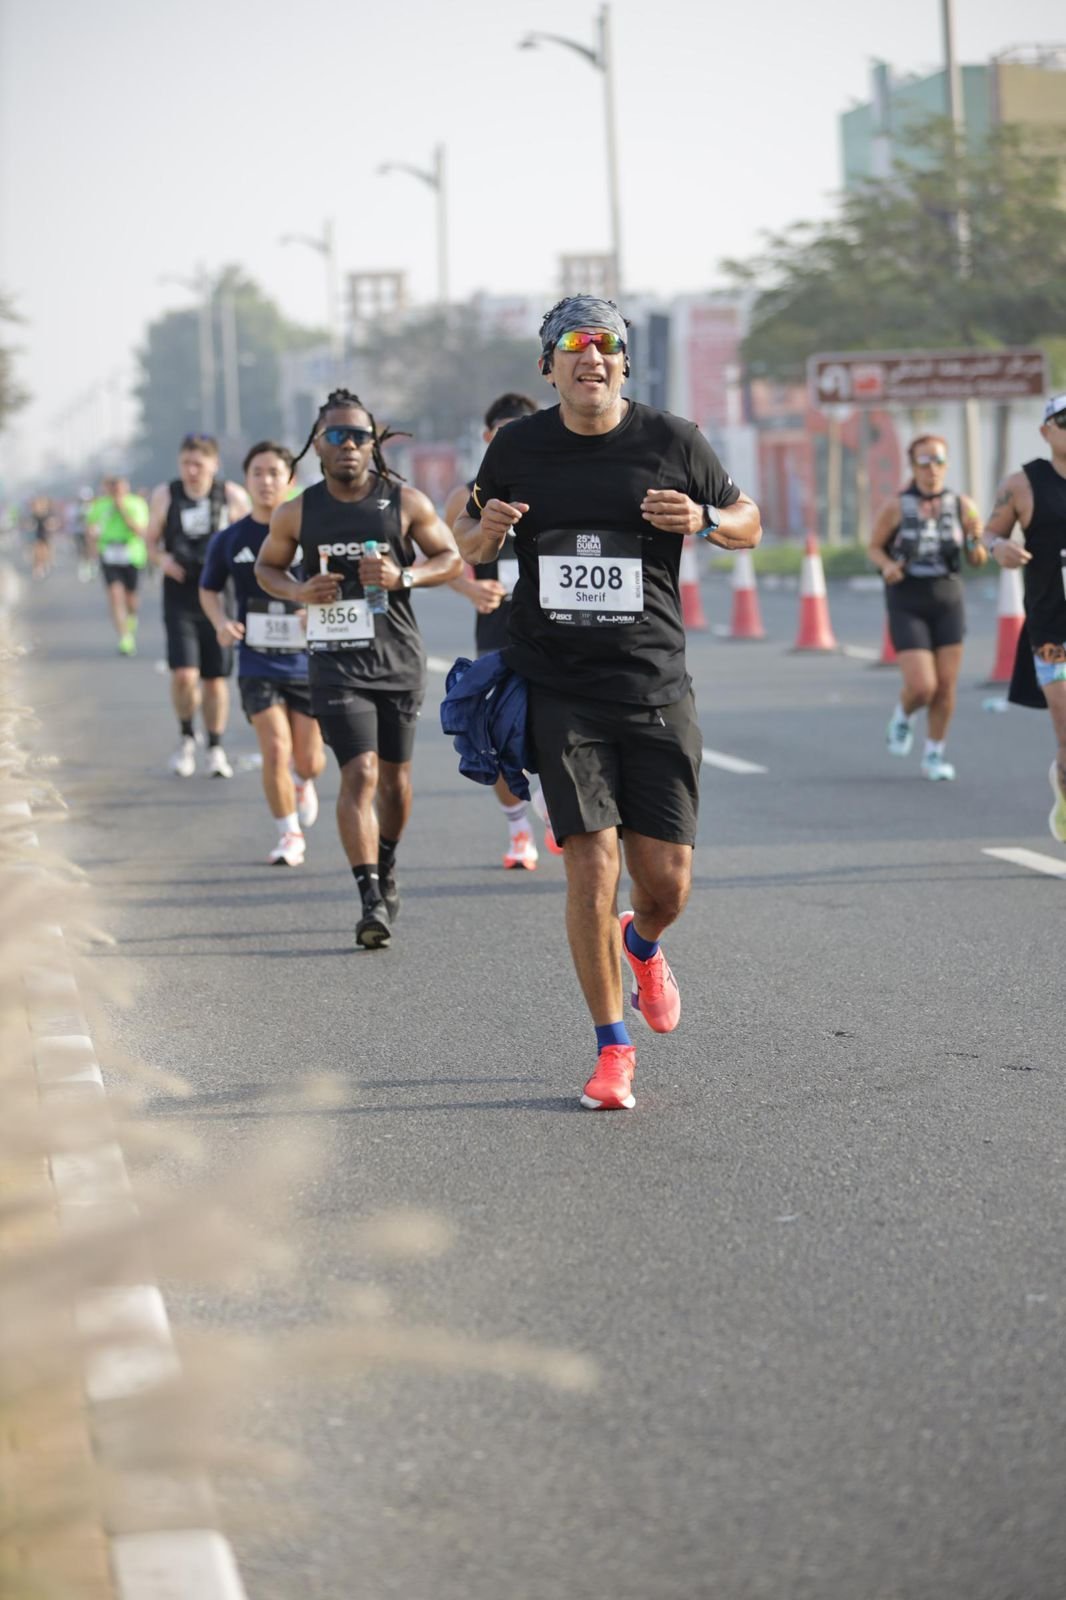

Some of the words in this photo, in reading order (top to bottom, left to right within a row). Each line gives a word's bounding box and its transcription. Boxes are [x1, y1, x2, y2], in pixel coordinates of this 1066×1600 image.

[318, 543, 390, 556] ROCP
[560, 565, 623, 589] 3208
[576, 591, 606, 602] Sherif
[319, 607, 358, 624] 3656
